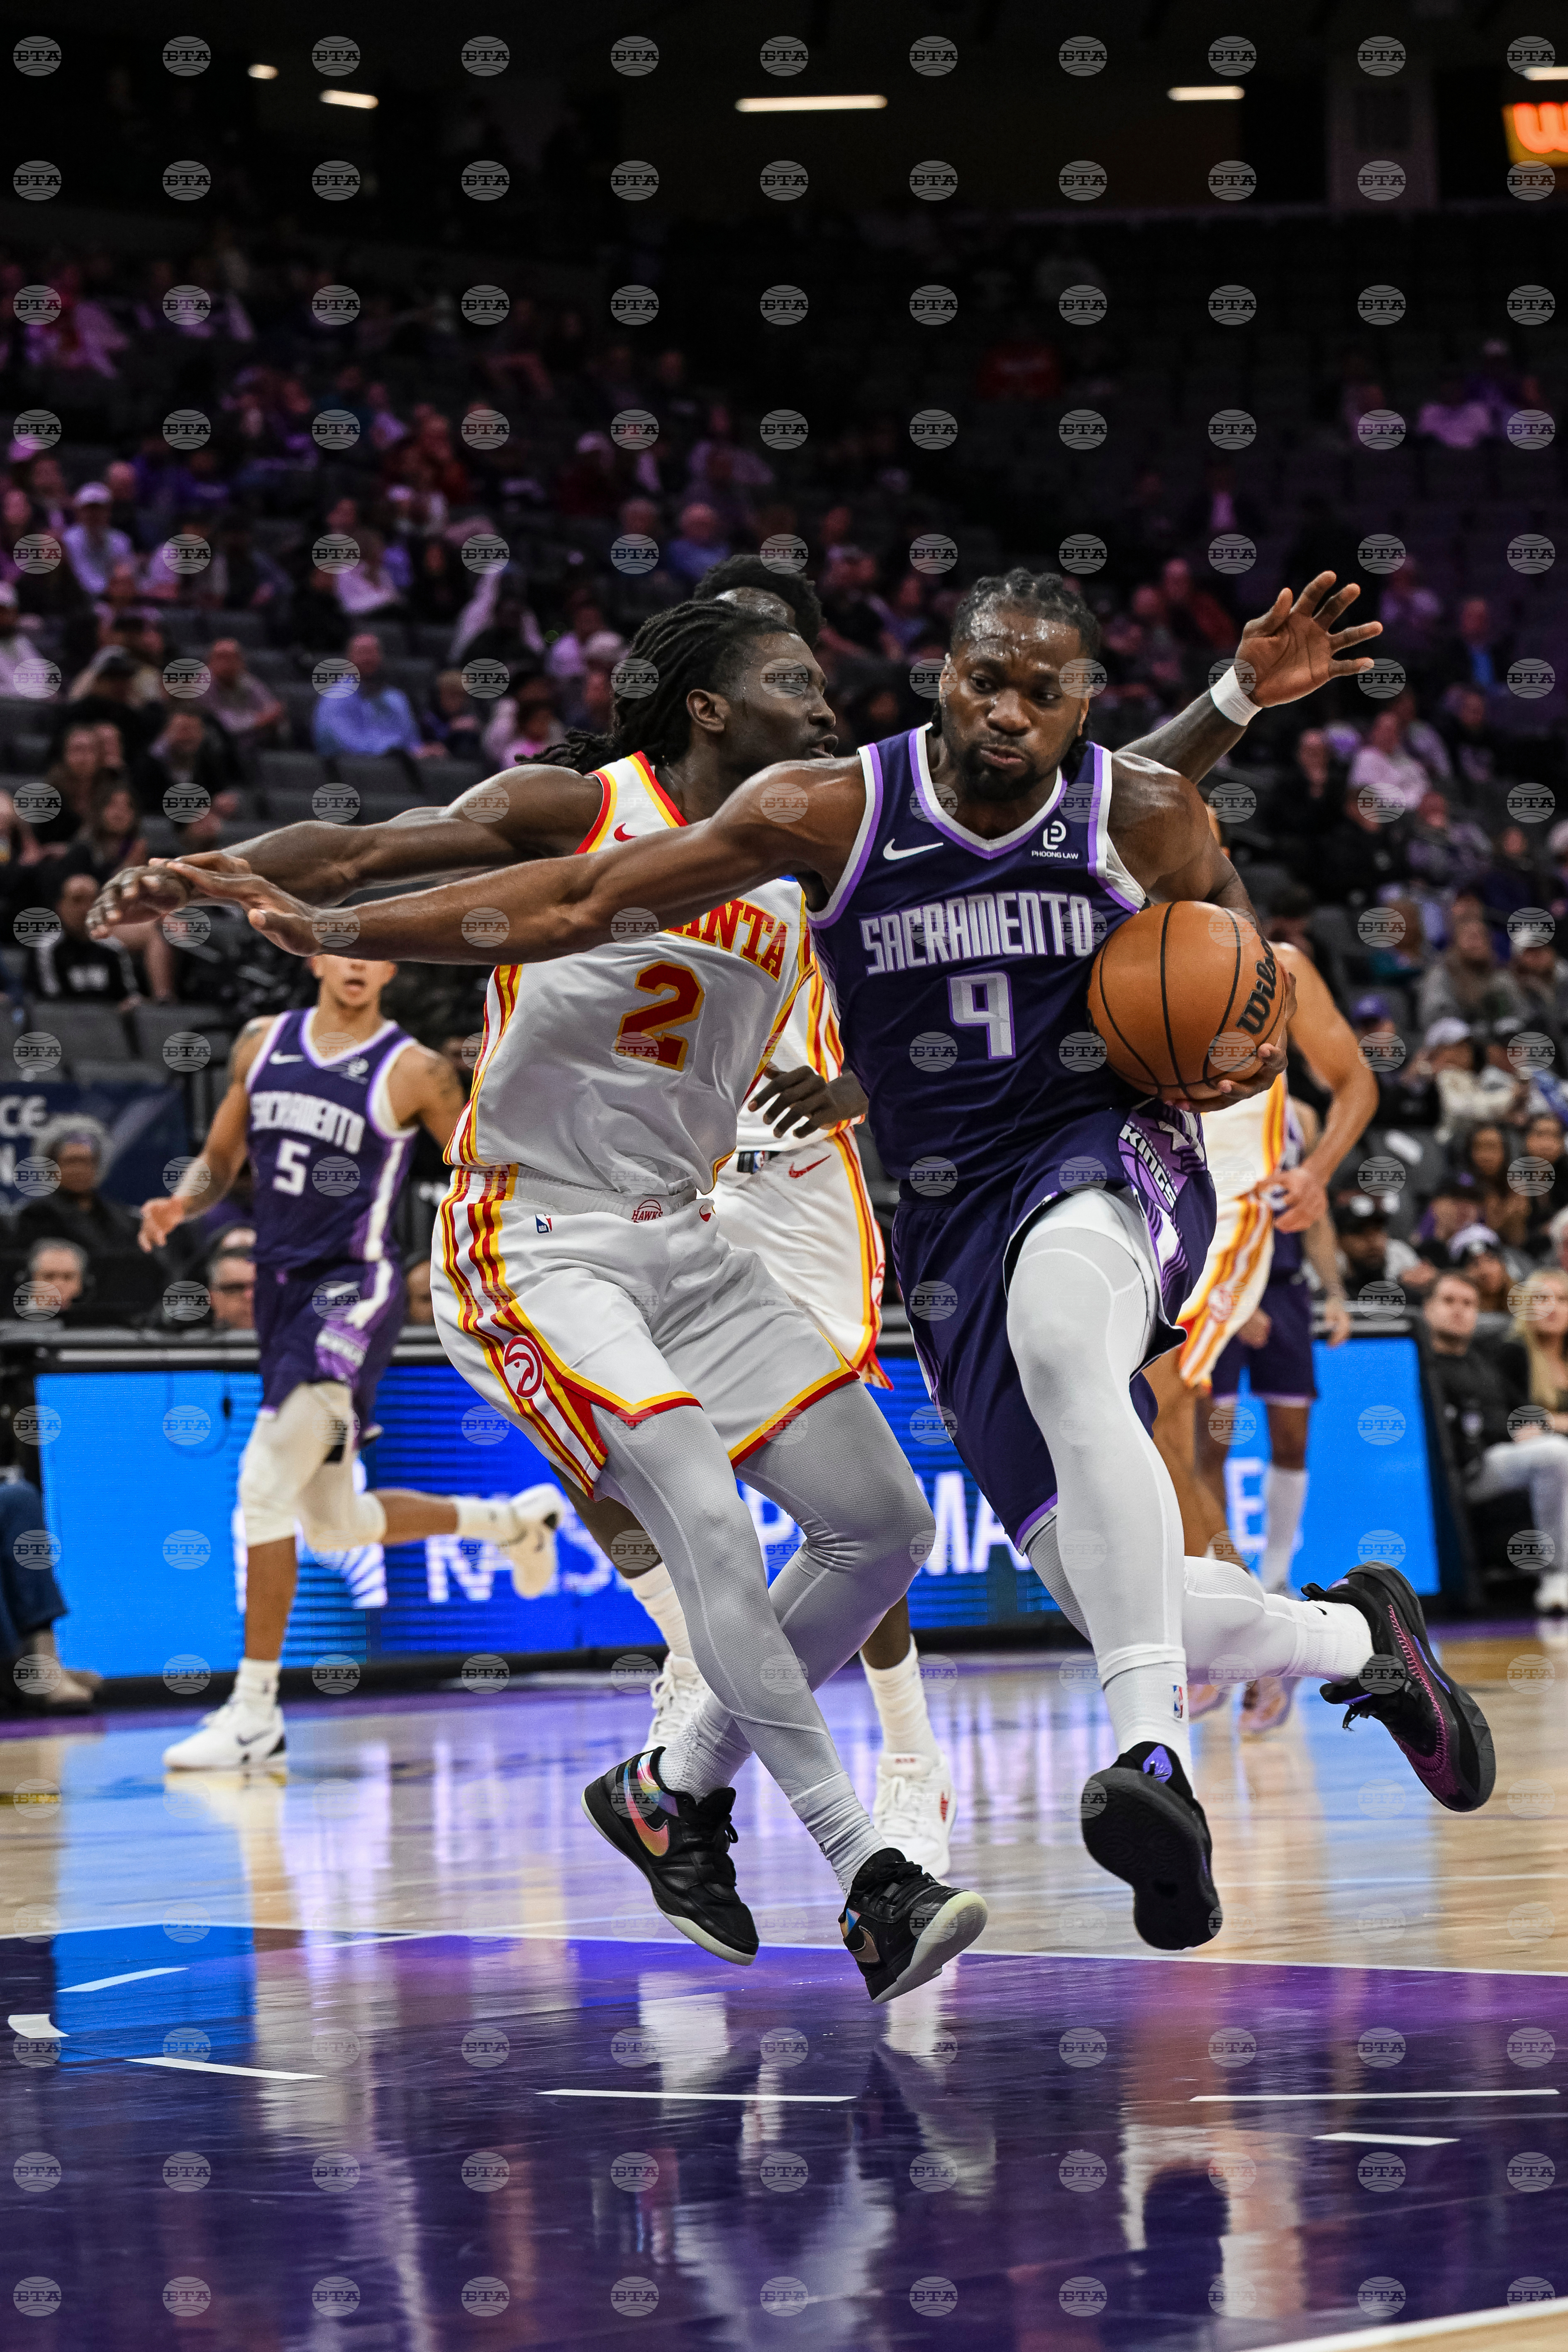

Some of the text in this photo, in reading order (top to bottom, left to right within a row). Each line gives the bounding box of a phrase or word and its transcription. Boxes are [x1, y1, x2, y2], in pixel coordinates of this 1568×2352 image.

[1063, 851, 1078, 859] LAW
[860, 890, 1094, 976] SACRAMENTO
[614, 960, 705, 1072] 2
[947, 970, 1016, 1060] 9
[272, 1138, 312, 1197] 5
[1119, 1124, 1177, 1209] KINGS
[631, 1209, 663, 1221] HAWKS
